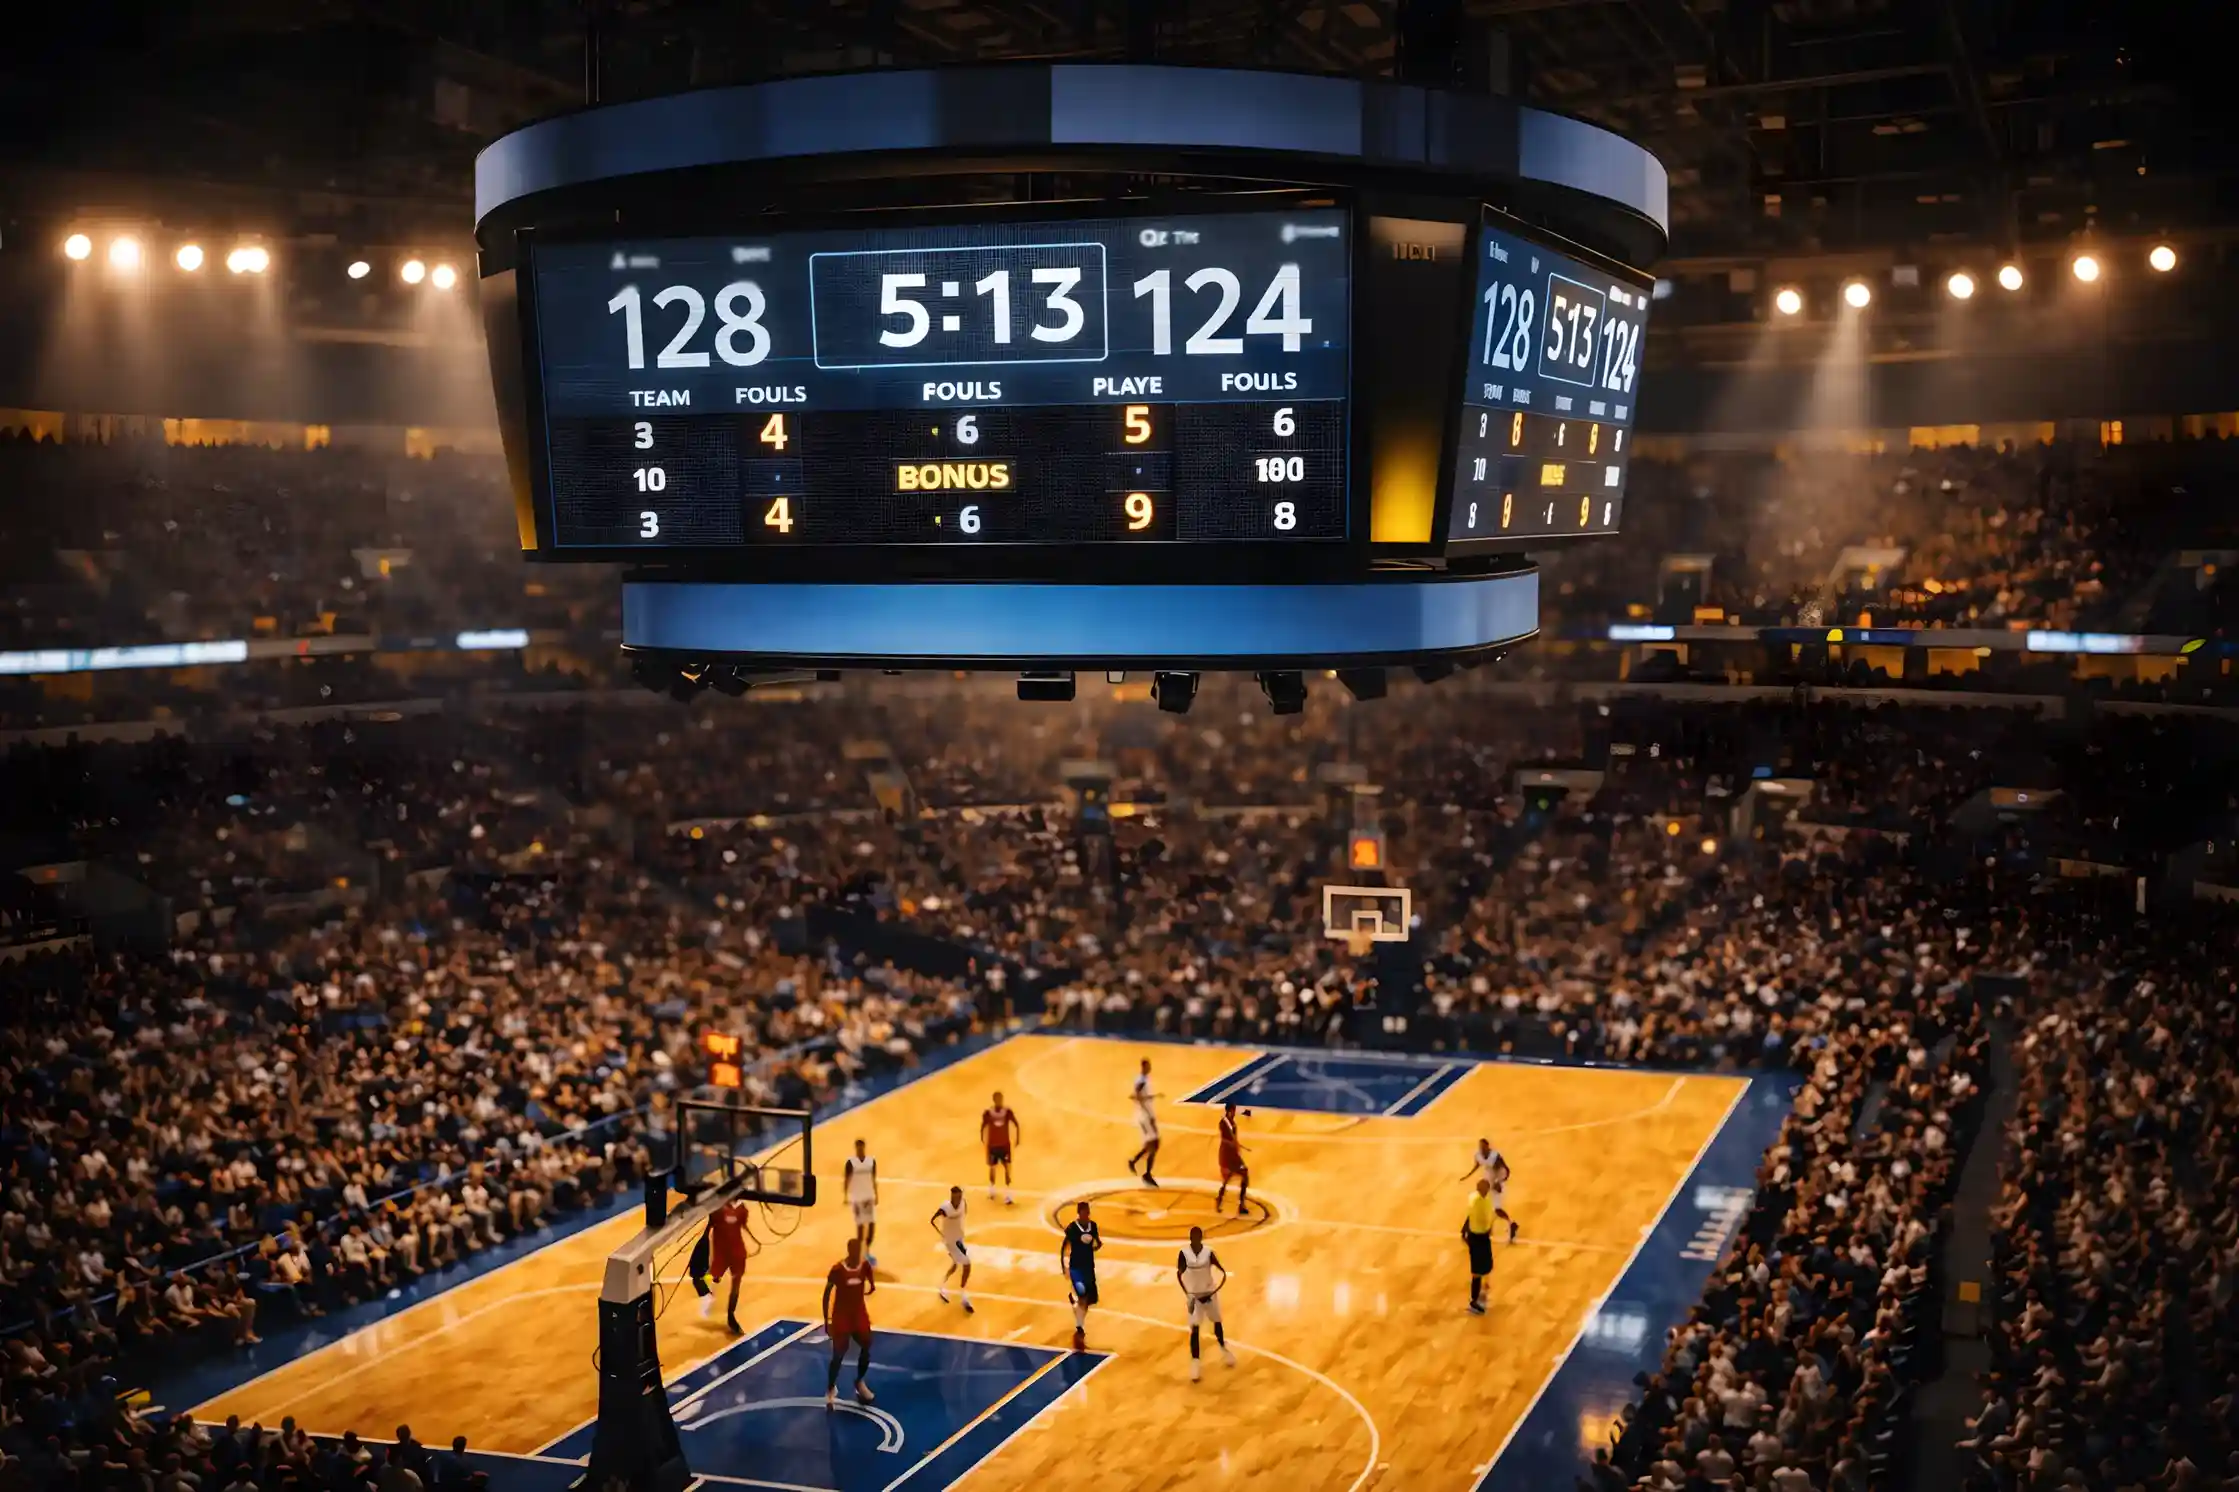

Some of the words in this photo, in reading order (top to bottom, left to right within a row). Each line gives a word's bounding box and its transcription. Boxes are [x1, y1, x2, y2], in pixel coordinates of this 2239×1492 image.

[879, 267, 1084, 348] 5:13
[1134, 263, 1312, 355] 124
[608, 281, 770, 369] 128
[1483, 283, 1534, 372] 128
[1602, 317, 1639, 393] 124
[629, 390, 690, 406] TEAM
[736, 386, 806, 403] FOULS
[923, 382, 1001, 401] FOULS
[1093, 377, 1163, 396] PLAYE
[1222, 372, 1297, 391] FOULS
[634, 422, 654, 449] 3
[760, 414, 788, 450] 4
[957, 415, 978, 444] 6
[1125, 405, 1152, 443] 5
[1273, 408, 1296, 437] 6
[632, 467, 666, 492] 10
[898, 464, 1009, 489] BONUS
[1473, 457, 1487, 481] 10
[639, 511, 660, 538] 3
[765, 498, 793, 533] 4
[959, 505, 980, 534] 6
[1124, 493, 1153, 530] 9
[1273, 501, 1297, 530] 8
